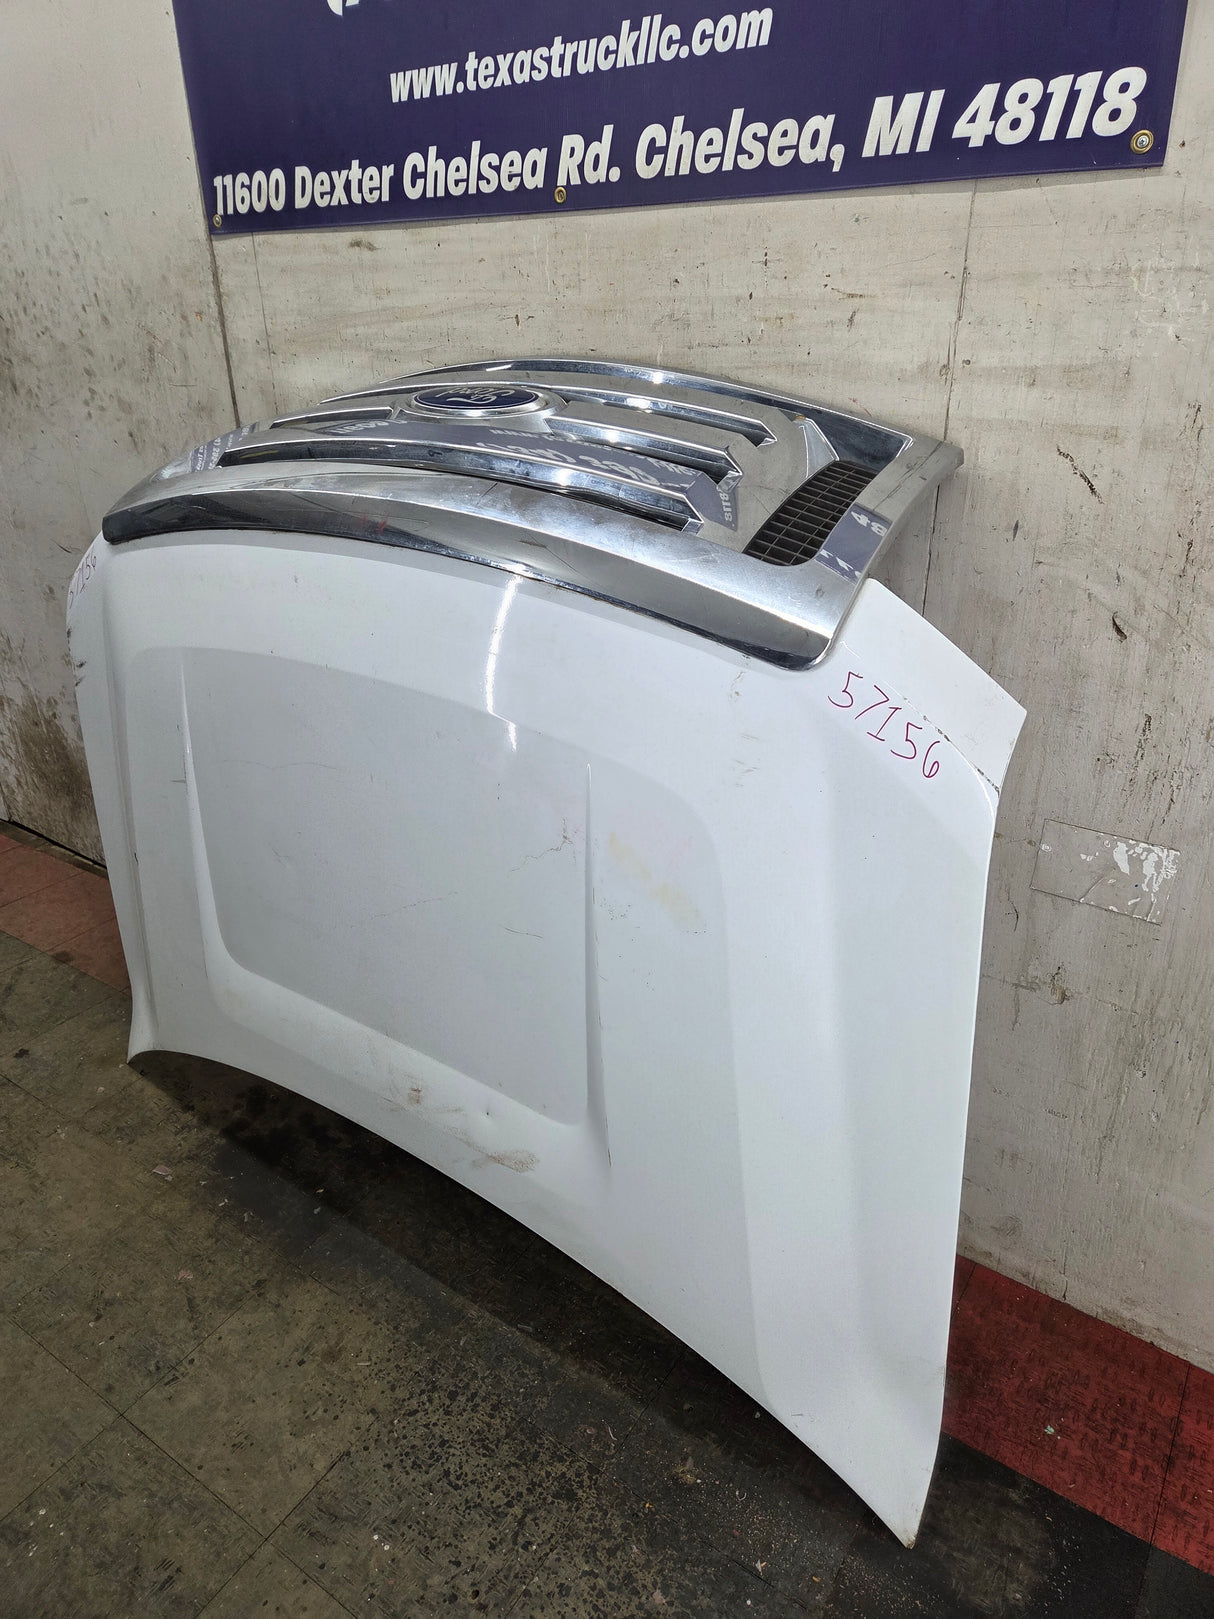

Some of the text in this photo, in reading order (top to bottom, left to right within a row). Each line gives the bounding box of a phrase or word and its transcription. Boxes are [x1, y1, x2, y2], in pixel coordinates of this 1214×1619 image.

[390, 7, 774, 103] www.texastruckllc.com
[213, 66, 1148, 216] 11600 Dexter Chelsea Rd. Chelsea, MI 48118
[827, 671, 941, 779] 57156
